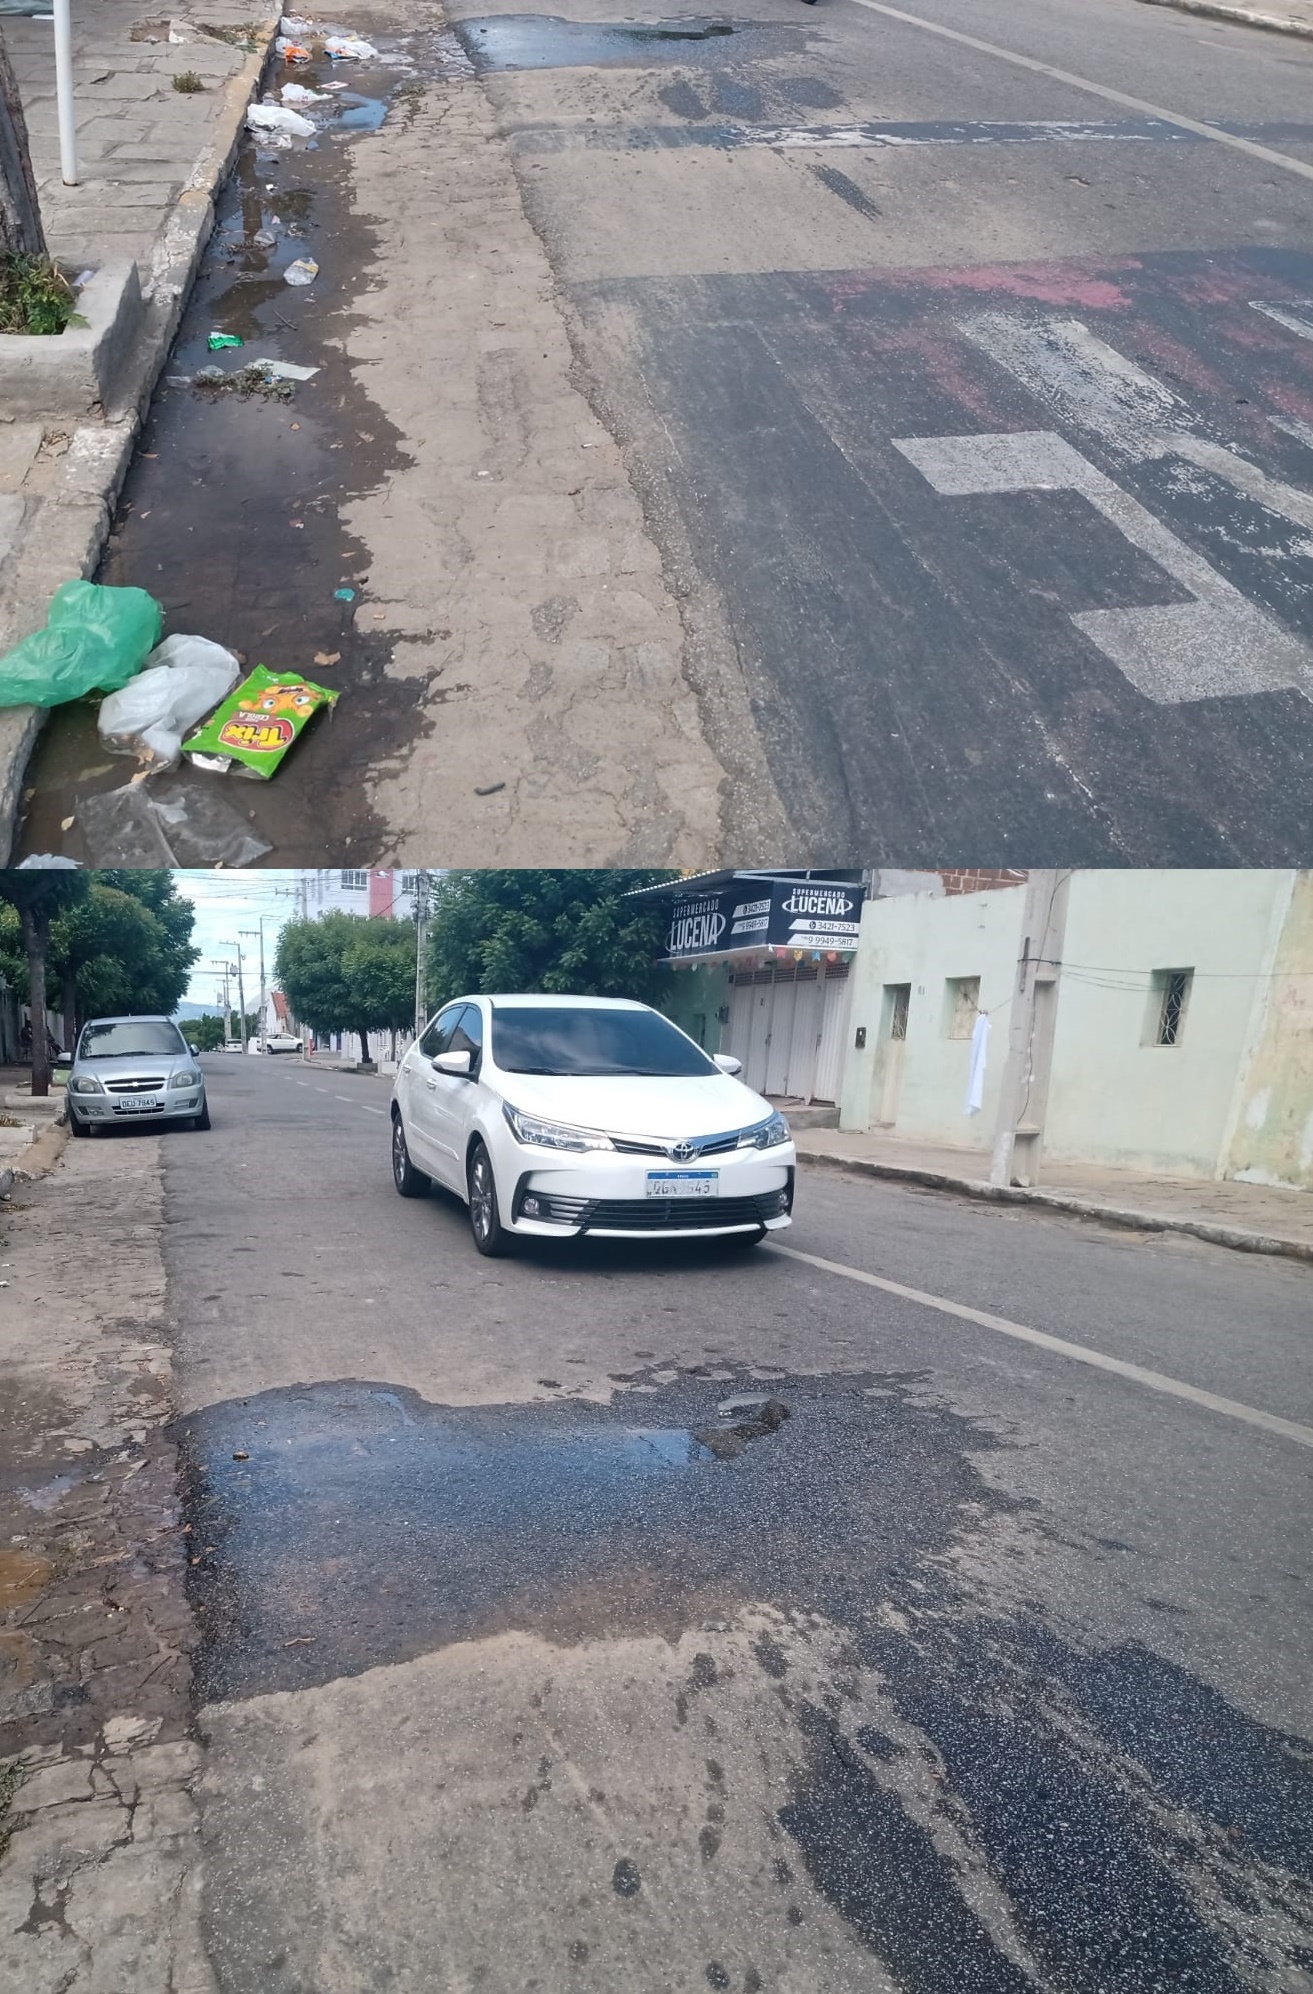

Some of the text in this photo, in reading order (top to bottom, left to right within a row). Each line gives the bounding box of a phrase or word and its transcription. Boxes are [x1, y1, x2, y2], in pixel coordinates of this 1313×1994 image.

[224, 725, 287, 747] Trix
[793, 888, 846, 898] SUPERMERCADO
[673, 898, 719, 917] SUPERMERCADO
[790, 895, 846, 916] LUCENA
[671, 912, 718, 951] LUCENA
[817, 921, 855, 932] 3421-7523
